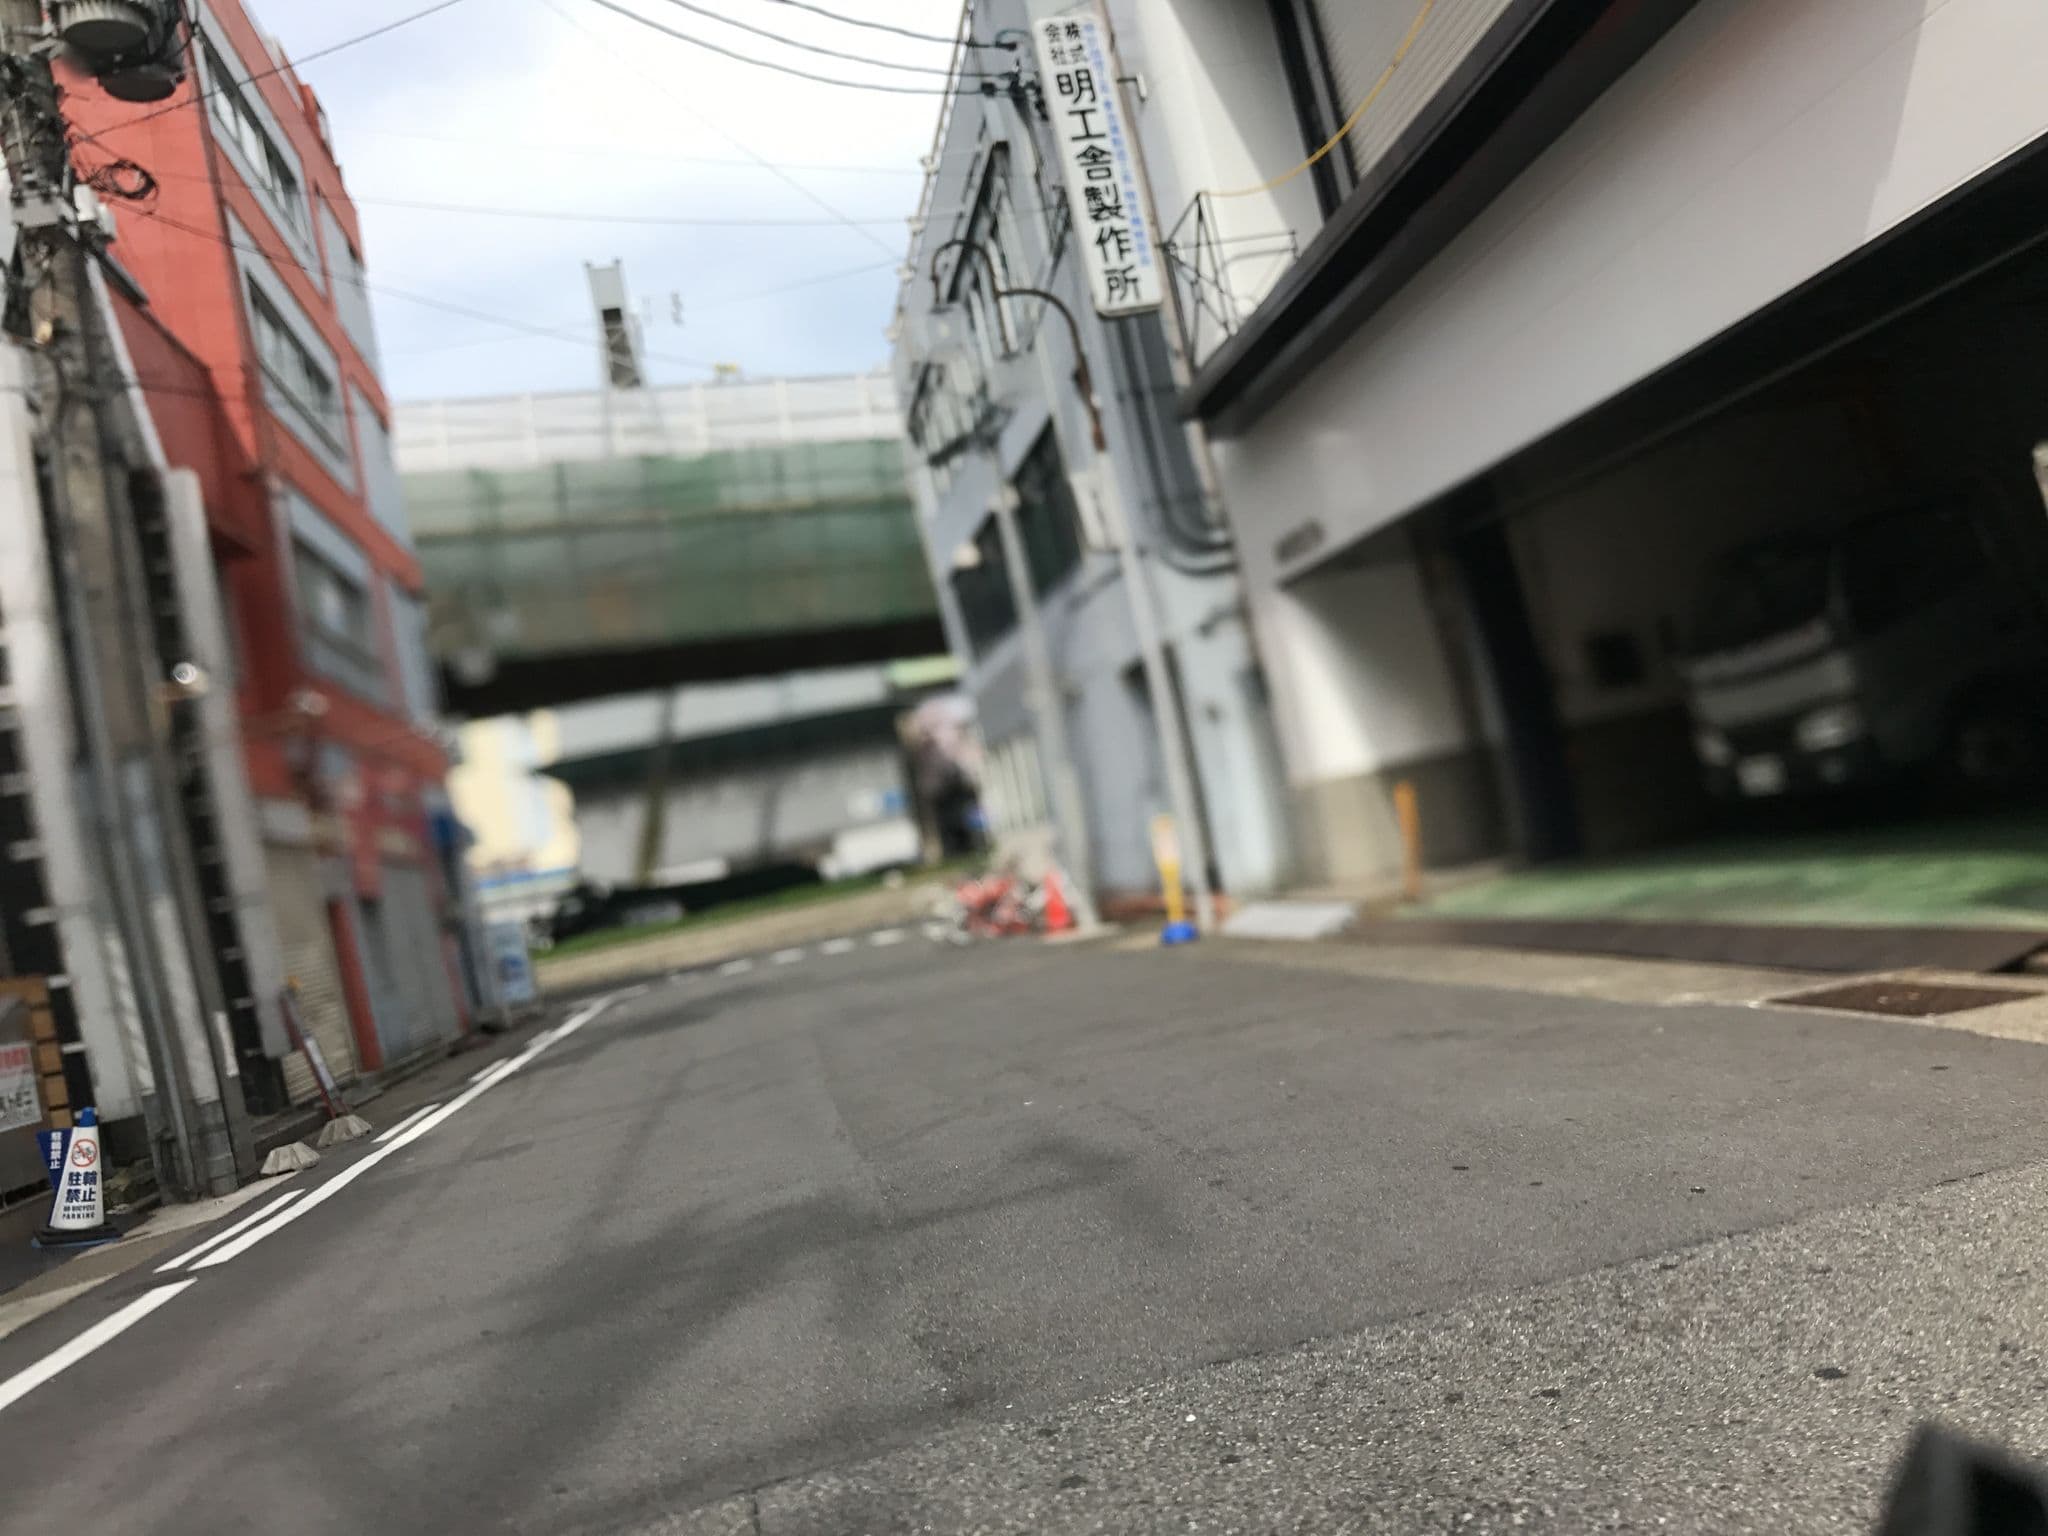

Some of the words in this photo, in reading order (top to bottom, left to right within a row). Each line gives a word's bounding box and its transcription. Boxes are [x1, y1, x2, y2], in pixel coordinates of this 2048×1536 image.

[67, 1171, 98, 1187] 駐輪
[65, 1187, 97, 1203] 禁止
[62, 1211, 96, 1220] PARKING
